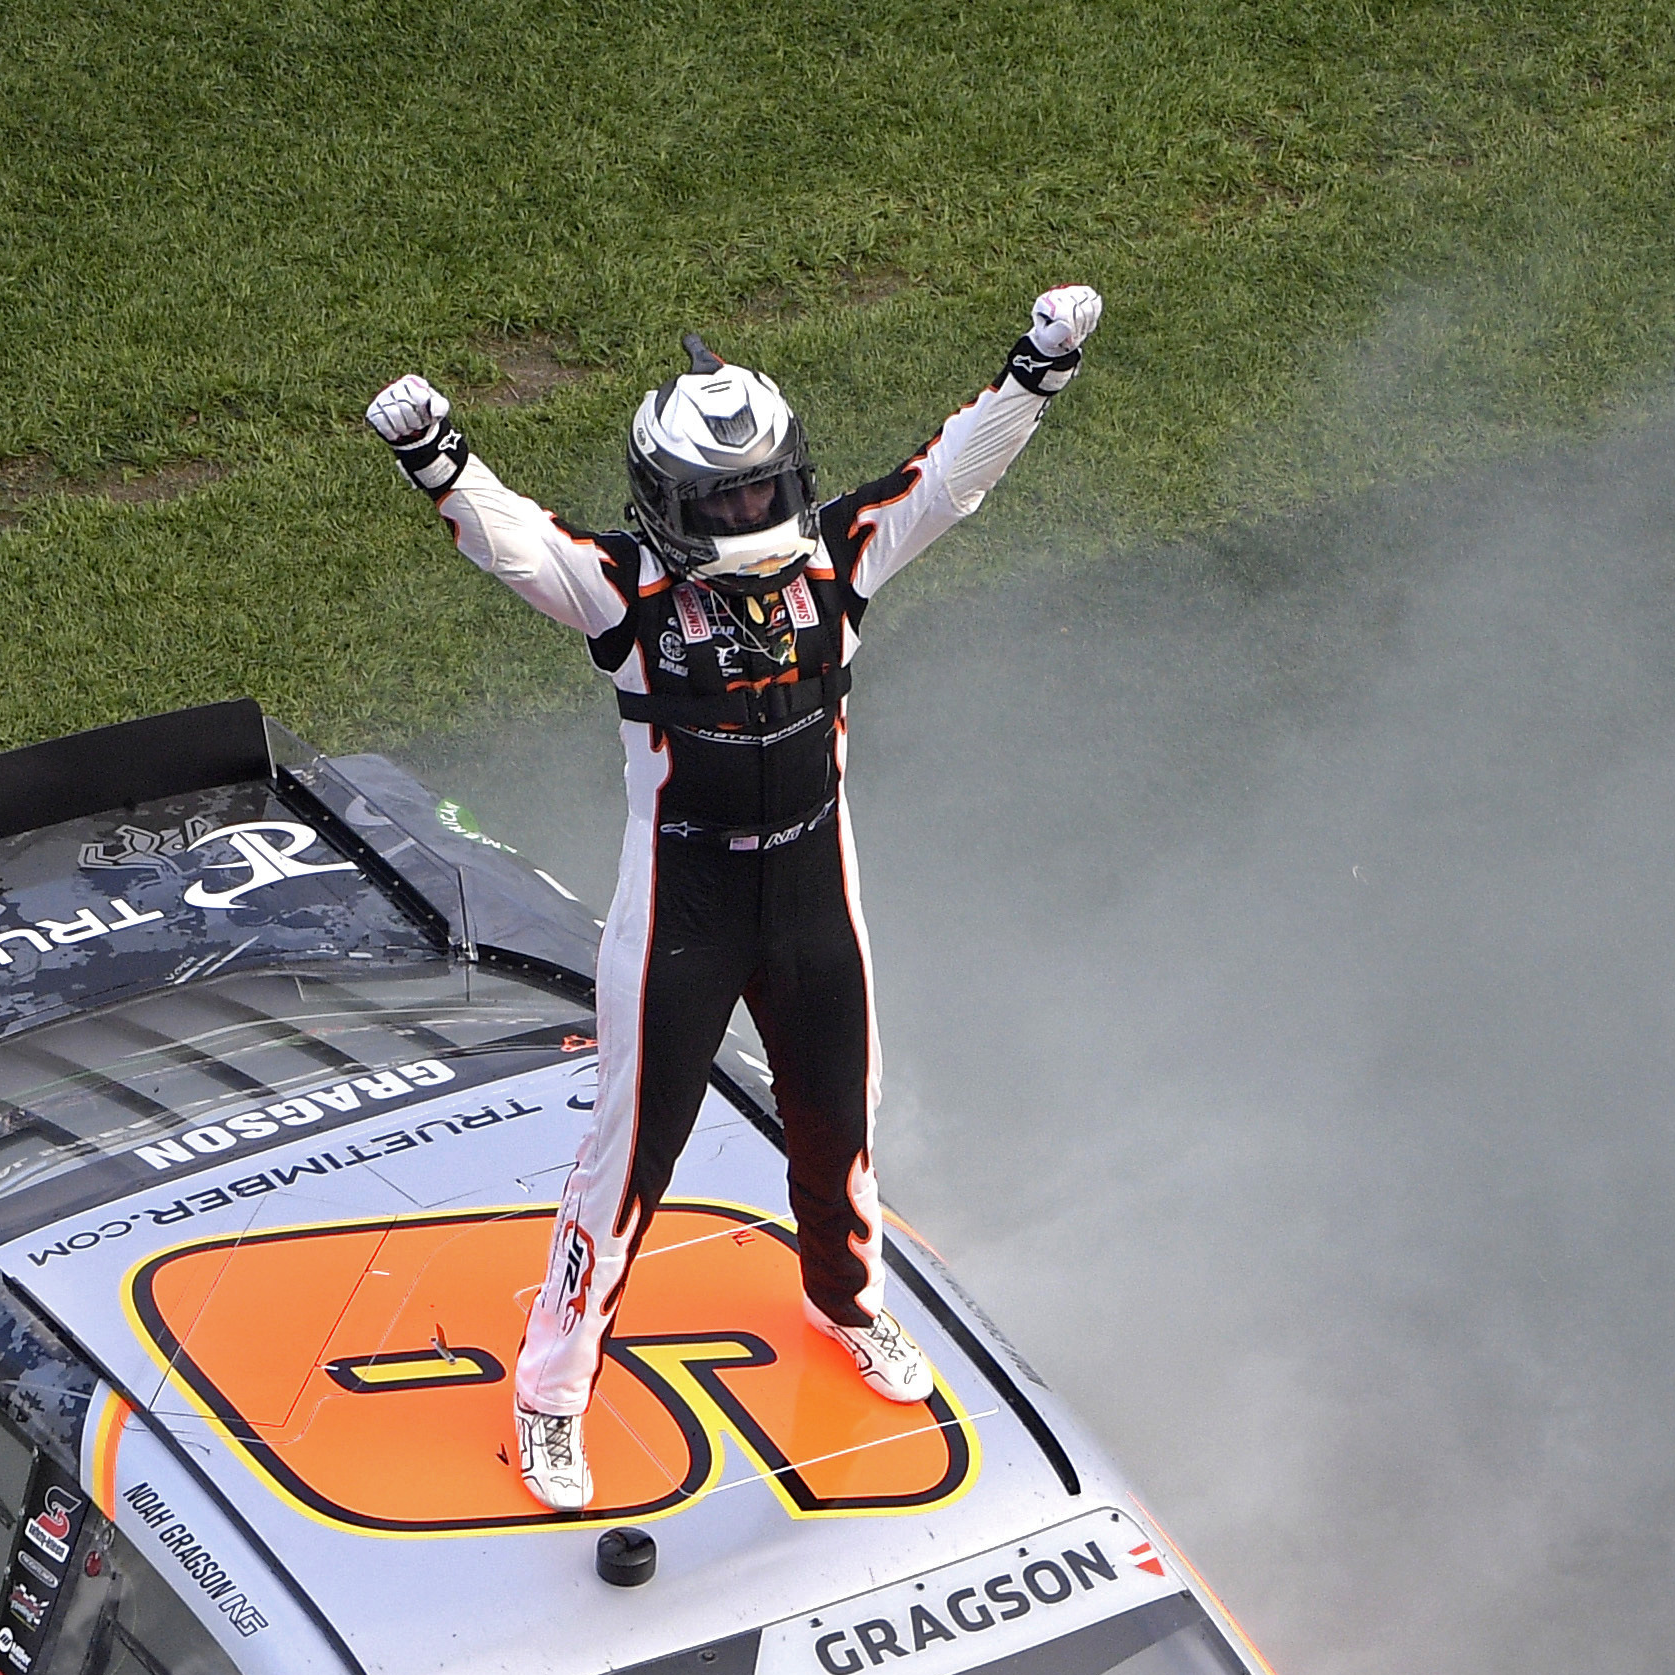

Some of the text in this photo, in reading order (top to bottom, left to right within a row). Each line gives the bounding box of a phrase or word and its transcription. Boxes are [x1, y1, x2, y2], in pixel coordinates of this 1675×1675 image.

[26, 1095, 544, 1267] TRUETIMBER.COM
[133, 1058, 458, 1170] GRAGSON
[119, 1195, 983, 1540] 9
[123, 1481, 168, 1530] NOAH
[162, 1523, 236, 1601] GRAGSON
